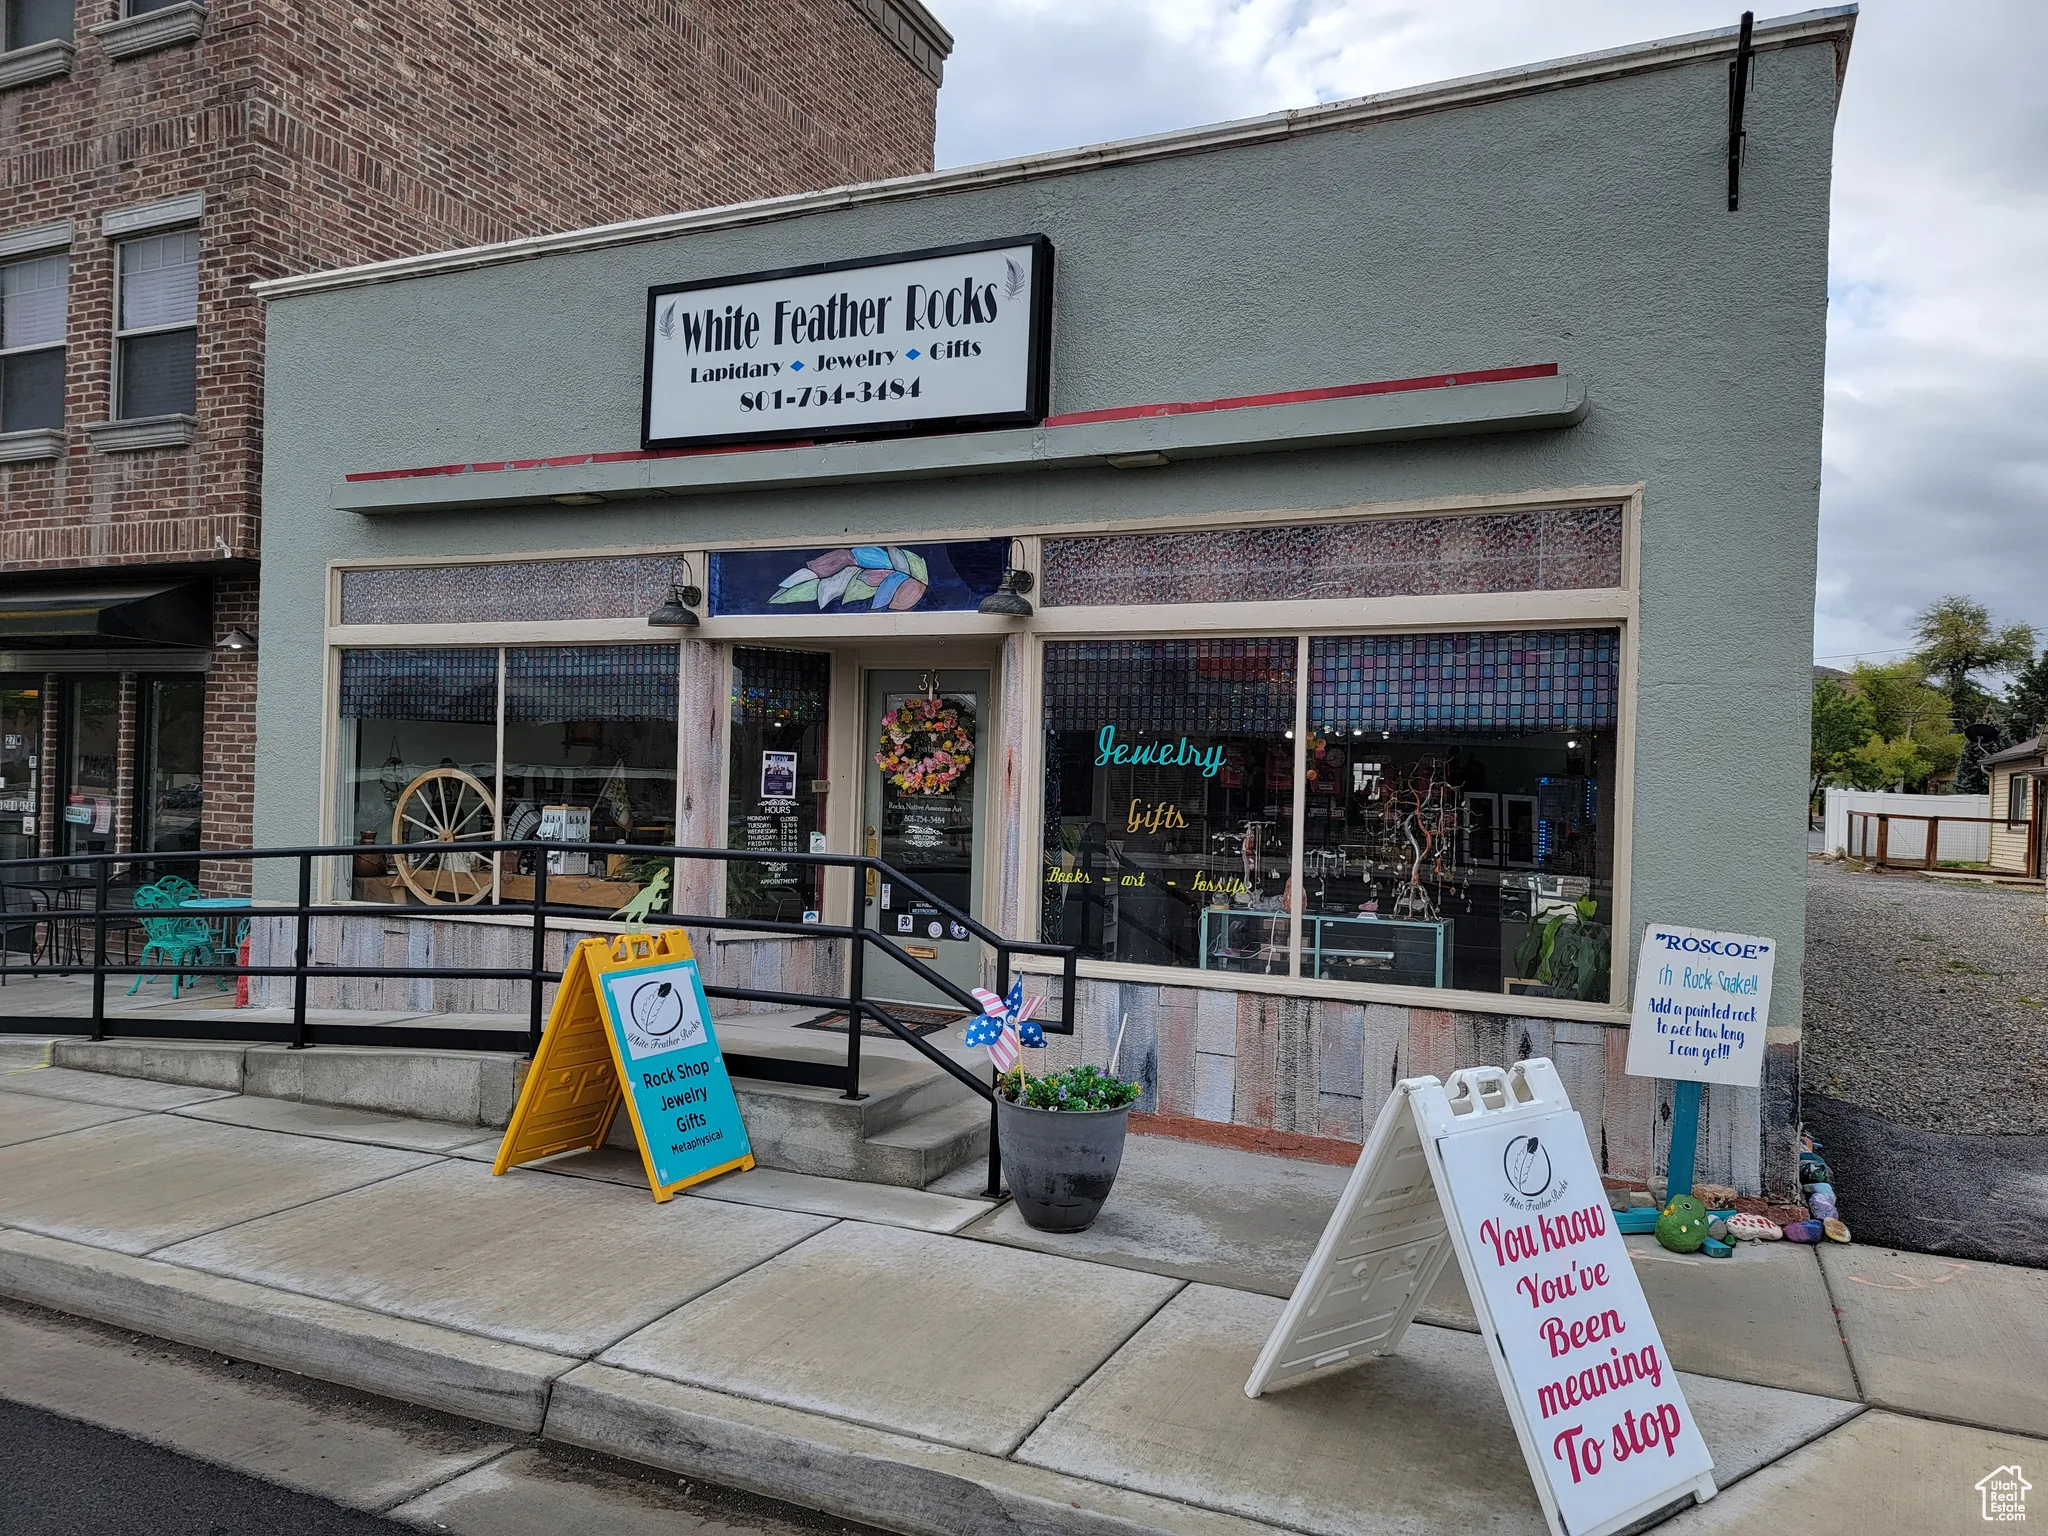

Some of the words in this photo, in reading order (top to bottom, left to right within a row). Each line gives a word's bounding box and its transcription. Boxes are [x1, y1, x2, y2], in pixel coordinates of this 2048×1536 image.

[681, 303, 760, 357] White
[773, 291, 892, 346] Feather
[905, 277, 998, 332] Rocks
[690, 358, 785, 384] Lapidary
[812, 347, 899, 373] Jewelry
[929, 338, 982, 361] Gifts
[738, 376, 923, 413] 801-754-3484
[6, 735, 16, 745] 27
[1094, 724, 1227, 778] Jewelry
[764, 806, 791, 814] HOURS
[906, 803, 924, 811] Native
[1126, 798, 1190, 834] Gifts
[1121, 872, 1146, 887] art
[1683, 966, 1713, 990] Rock
[1648, 997, 1672, 1014] Add
[1673, 1005, 1682, 1015] a
[1685, 1002, 1730, 1024] painted
[1732, 1006, 1758, 1023] rock
[627, 1031, 649, 1050] White
[650, 1035, 681, 1050] Feather
[680, 1019, 701, 1041] Rocks
[1657, 1017, 1668, 1034] to
[1670, 1025, 1692, 1036] see
[1695, 1020, 1718, 1039] how
[1721, 1023, 1745, 1049] long
[1668, 1039, 1676, 1055] I
[1678, 1045, 1699, 1057] can
[1702, 1043, 1731, 1066] get!!
[642, 1066, 677, 1089] Rock
[678, 1059, 711, 1081] Shop
[661, 1086, 708, 1112] Jewelry
[676, 1112, 707, 1134] Gifts
[671, 1128, 724, 1155] Metaphysical
[1502, 1192, 1524, 1211] White
[1524, 1196, 1553, 1213] Feather
[1552, 1179, 1569, 1205] Rocks
[1479, 1216, 1539, 1267] You
[1538, 1203, 1606, 1254] know
[1516, 1260, 1610, 1309] You've
[1539, 1307, 1626, 1359] Been
[1537, 1343, 1662, 1420] meaning
[1553, 1424, 1605, 1484] To
[1611, 1402, 1682, 1463] stop
